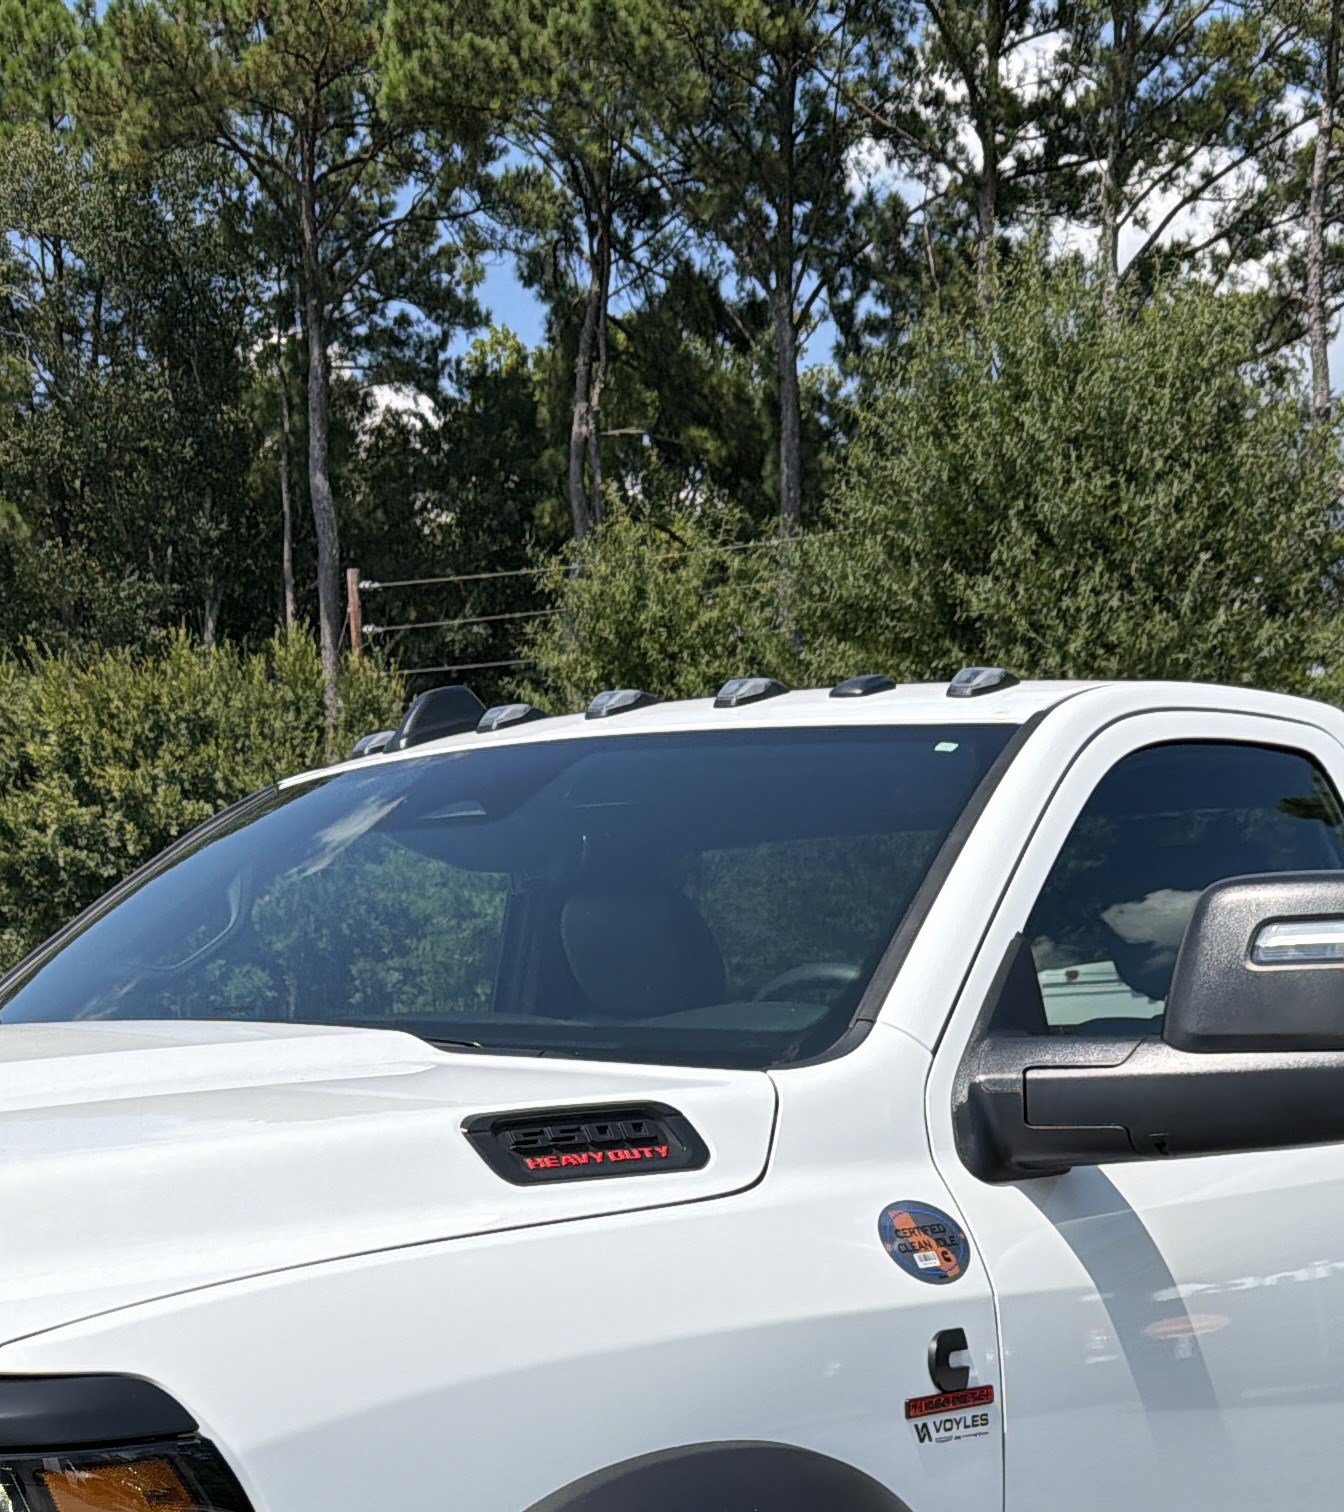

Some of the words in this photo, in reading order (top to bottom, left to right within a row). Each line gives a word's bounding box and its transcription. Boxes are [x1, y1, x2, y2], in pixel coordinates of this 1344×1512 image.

[507, 1120, 656, 1151] 5500
[524, 1152, 605, 1171] HEAVY
[608, 1145, 670, 1163] DUTY
[895, 1223, 946, 1239] CERTIFIED
[933, 1413, 989, 1433] VOYLES
